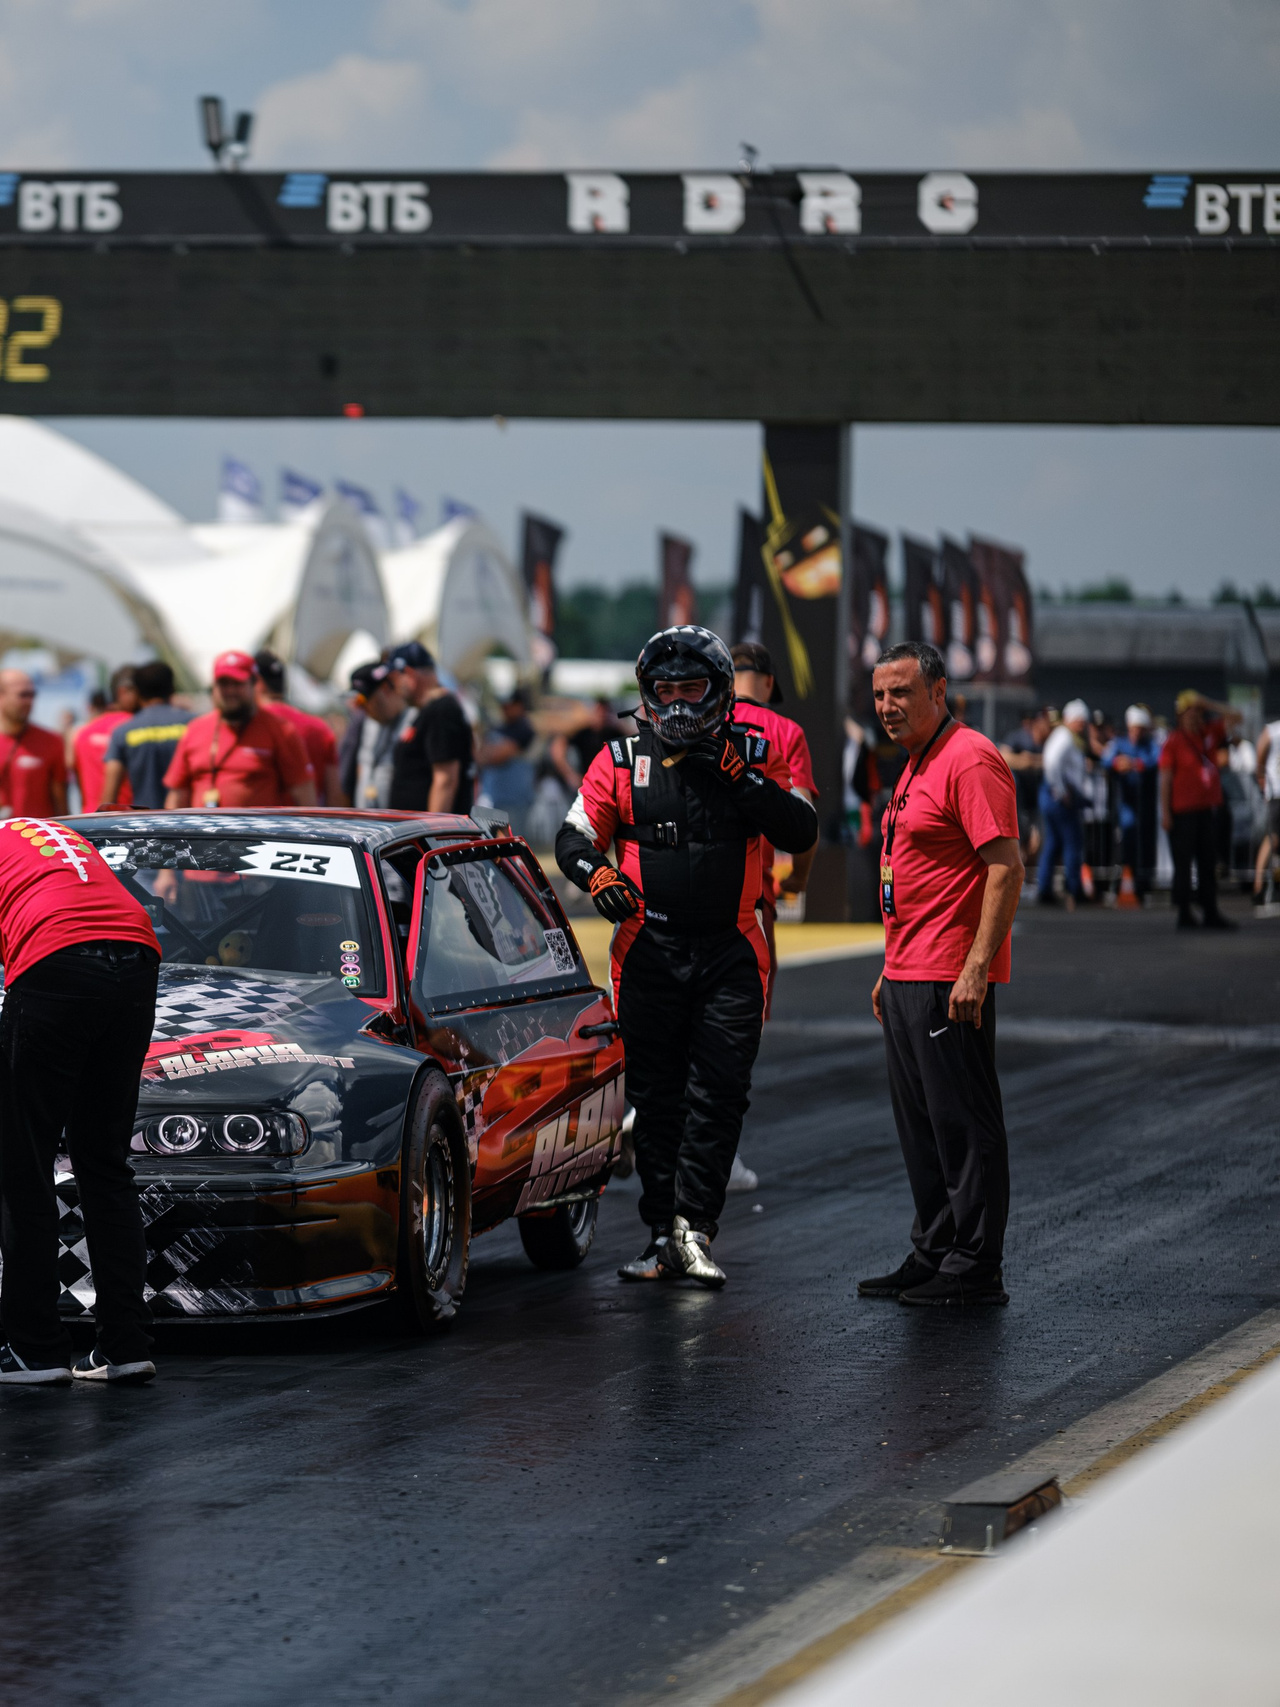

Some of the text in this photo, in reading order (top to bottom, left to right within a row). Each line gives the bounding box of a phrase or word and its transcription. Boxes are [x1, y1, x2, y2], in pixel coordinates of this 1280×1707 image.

[18, 180, 121, 231] ВТБ
[326, 181, 431, 232] ВТБ
[270, 851, 332, 876] 23
[158, 1042, 307, 1074] ALANIA
[166, 1053, 355, 1080] MOTOR SPORT
